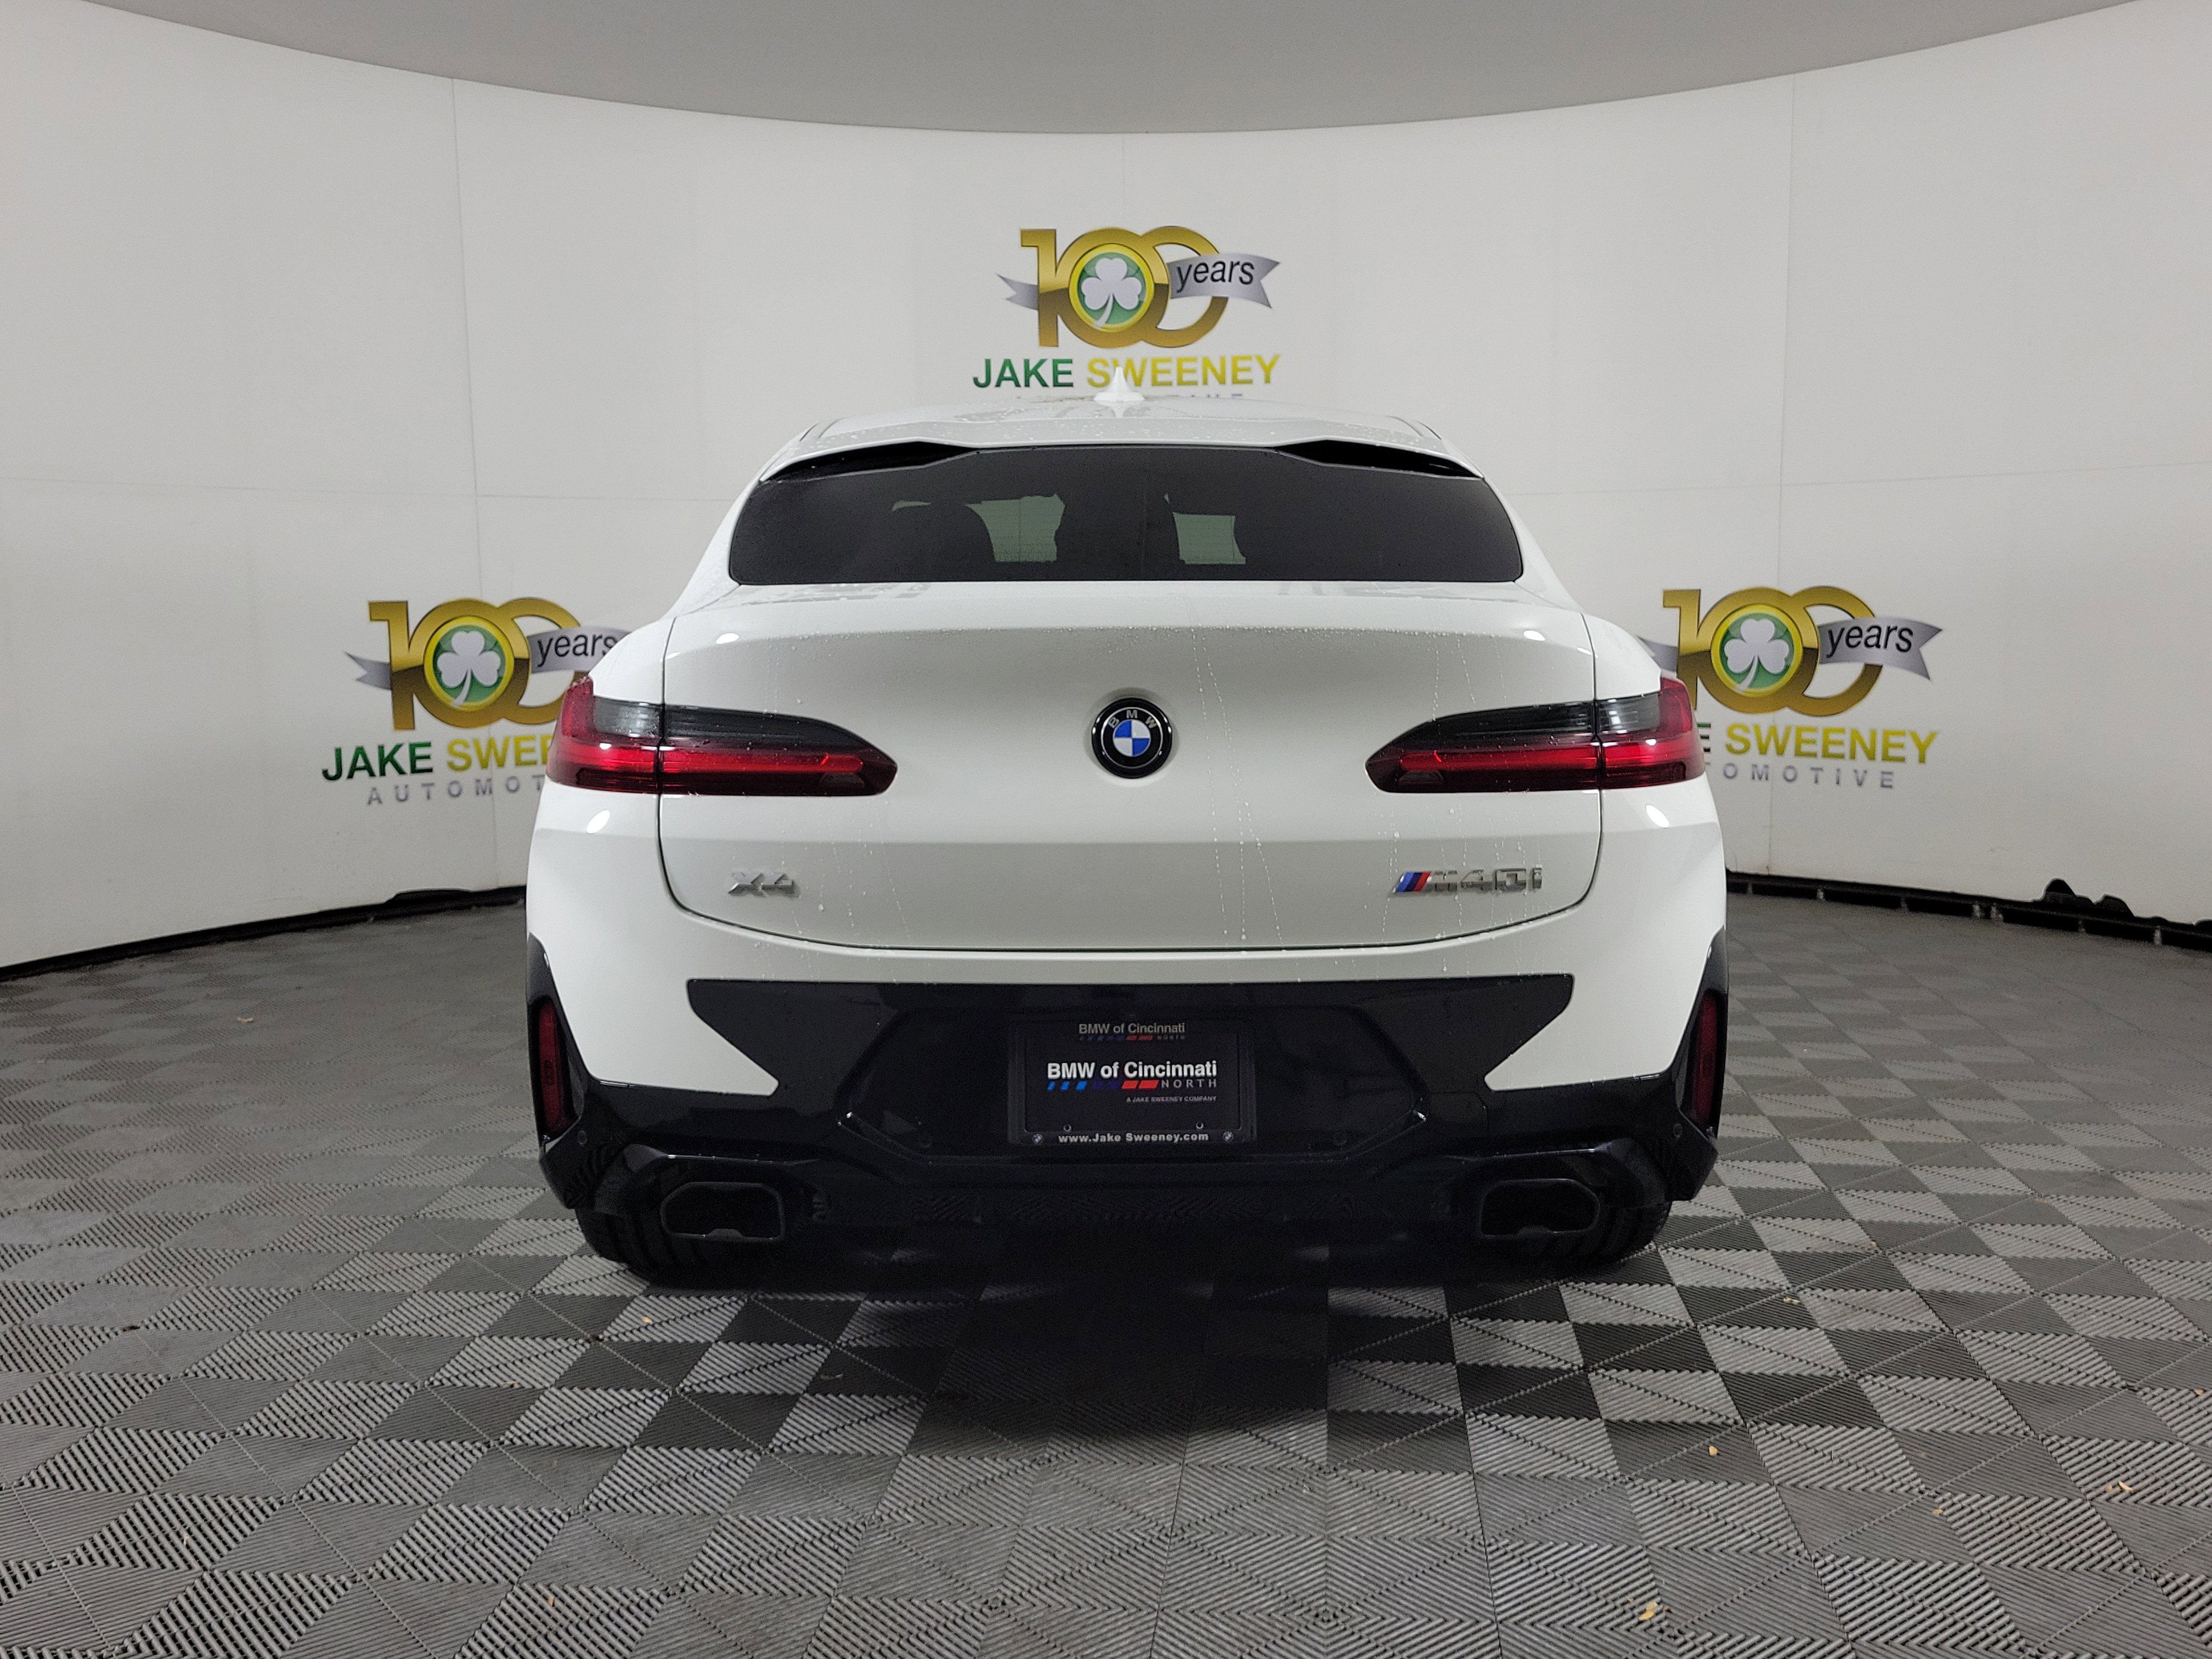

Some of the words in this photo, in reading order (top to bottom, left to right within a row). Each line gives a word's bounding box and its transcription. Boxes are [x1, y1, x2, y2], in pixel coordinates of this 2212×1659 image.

[1020, 226, 1229, 348] 100
[1177, 259, 1255, 293] years
[973, 358, 1074, 388] JAKE
[1086, 354, 1281, 388] SWEENEY
[537, 633, 618, 668] years
[1826, 624, 1914, 659] years
[1108, 709, 1158, 729] BMW
[321, 741, 433, 782] JAKE
[447, 734, 554, 772] SWEE
[1725, 723, 1938, 764] SWEENEY
[367, 773, 546, 806] AUTOMOT
[1705, 761, 1895, 789] OMOTIVE
[727, 871, 800, 899] X4
[1079, 1023, 1110, 1034] BMW
[1113, 1023, 1125, 1034] of
[1128, 1022, 1186, 1034] Cincinnati
[1047, 1062, 1096, 1080] BMW
[1100, 1062, 1120, 1079] of
[1124, 1060, 1217, 1079] Cincinnati
[1161, 1079, 1217, 1089] NORTH
[1058, 1133, 1121, 1143] www.Jake
[1126, 1132, 1209, 1144] Sweeney.com
